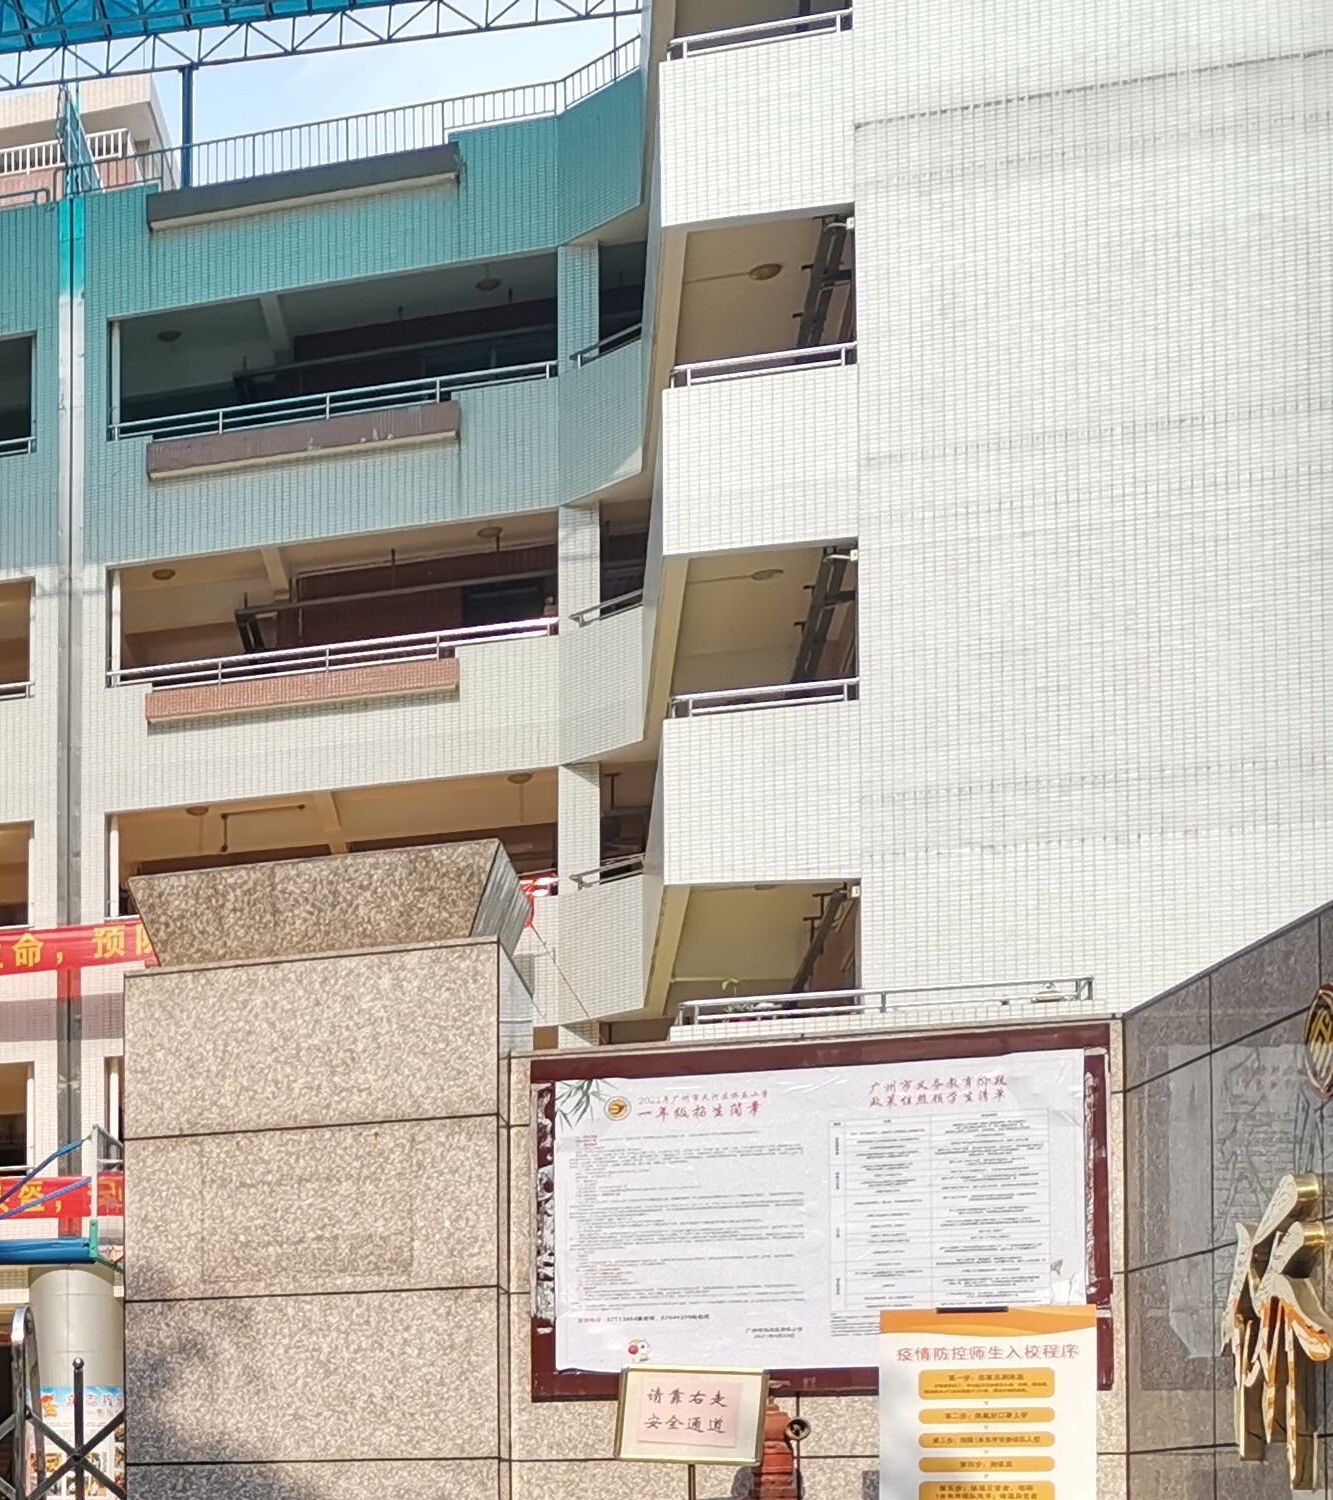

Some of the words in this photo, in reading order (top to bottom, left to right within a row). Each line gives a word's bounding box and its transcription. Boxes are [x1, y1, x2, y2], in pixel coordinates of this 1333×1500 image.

[637, 1100, 761, 1121] 一年级招生简章
[897, 1344, 1079, 1362] 疫情防控师生入校程序
[647, 1386, 728, 1408] 请靠右走
[644, 1413, 726, 1434] 安全通道
